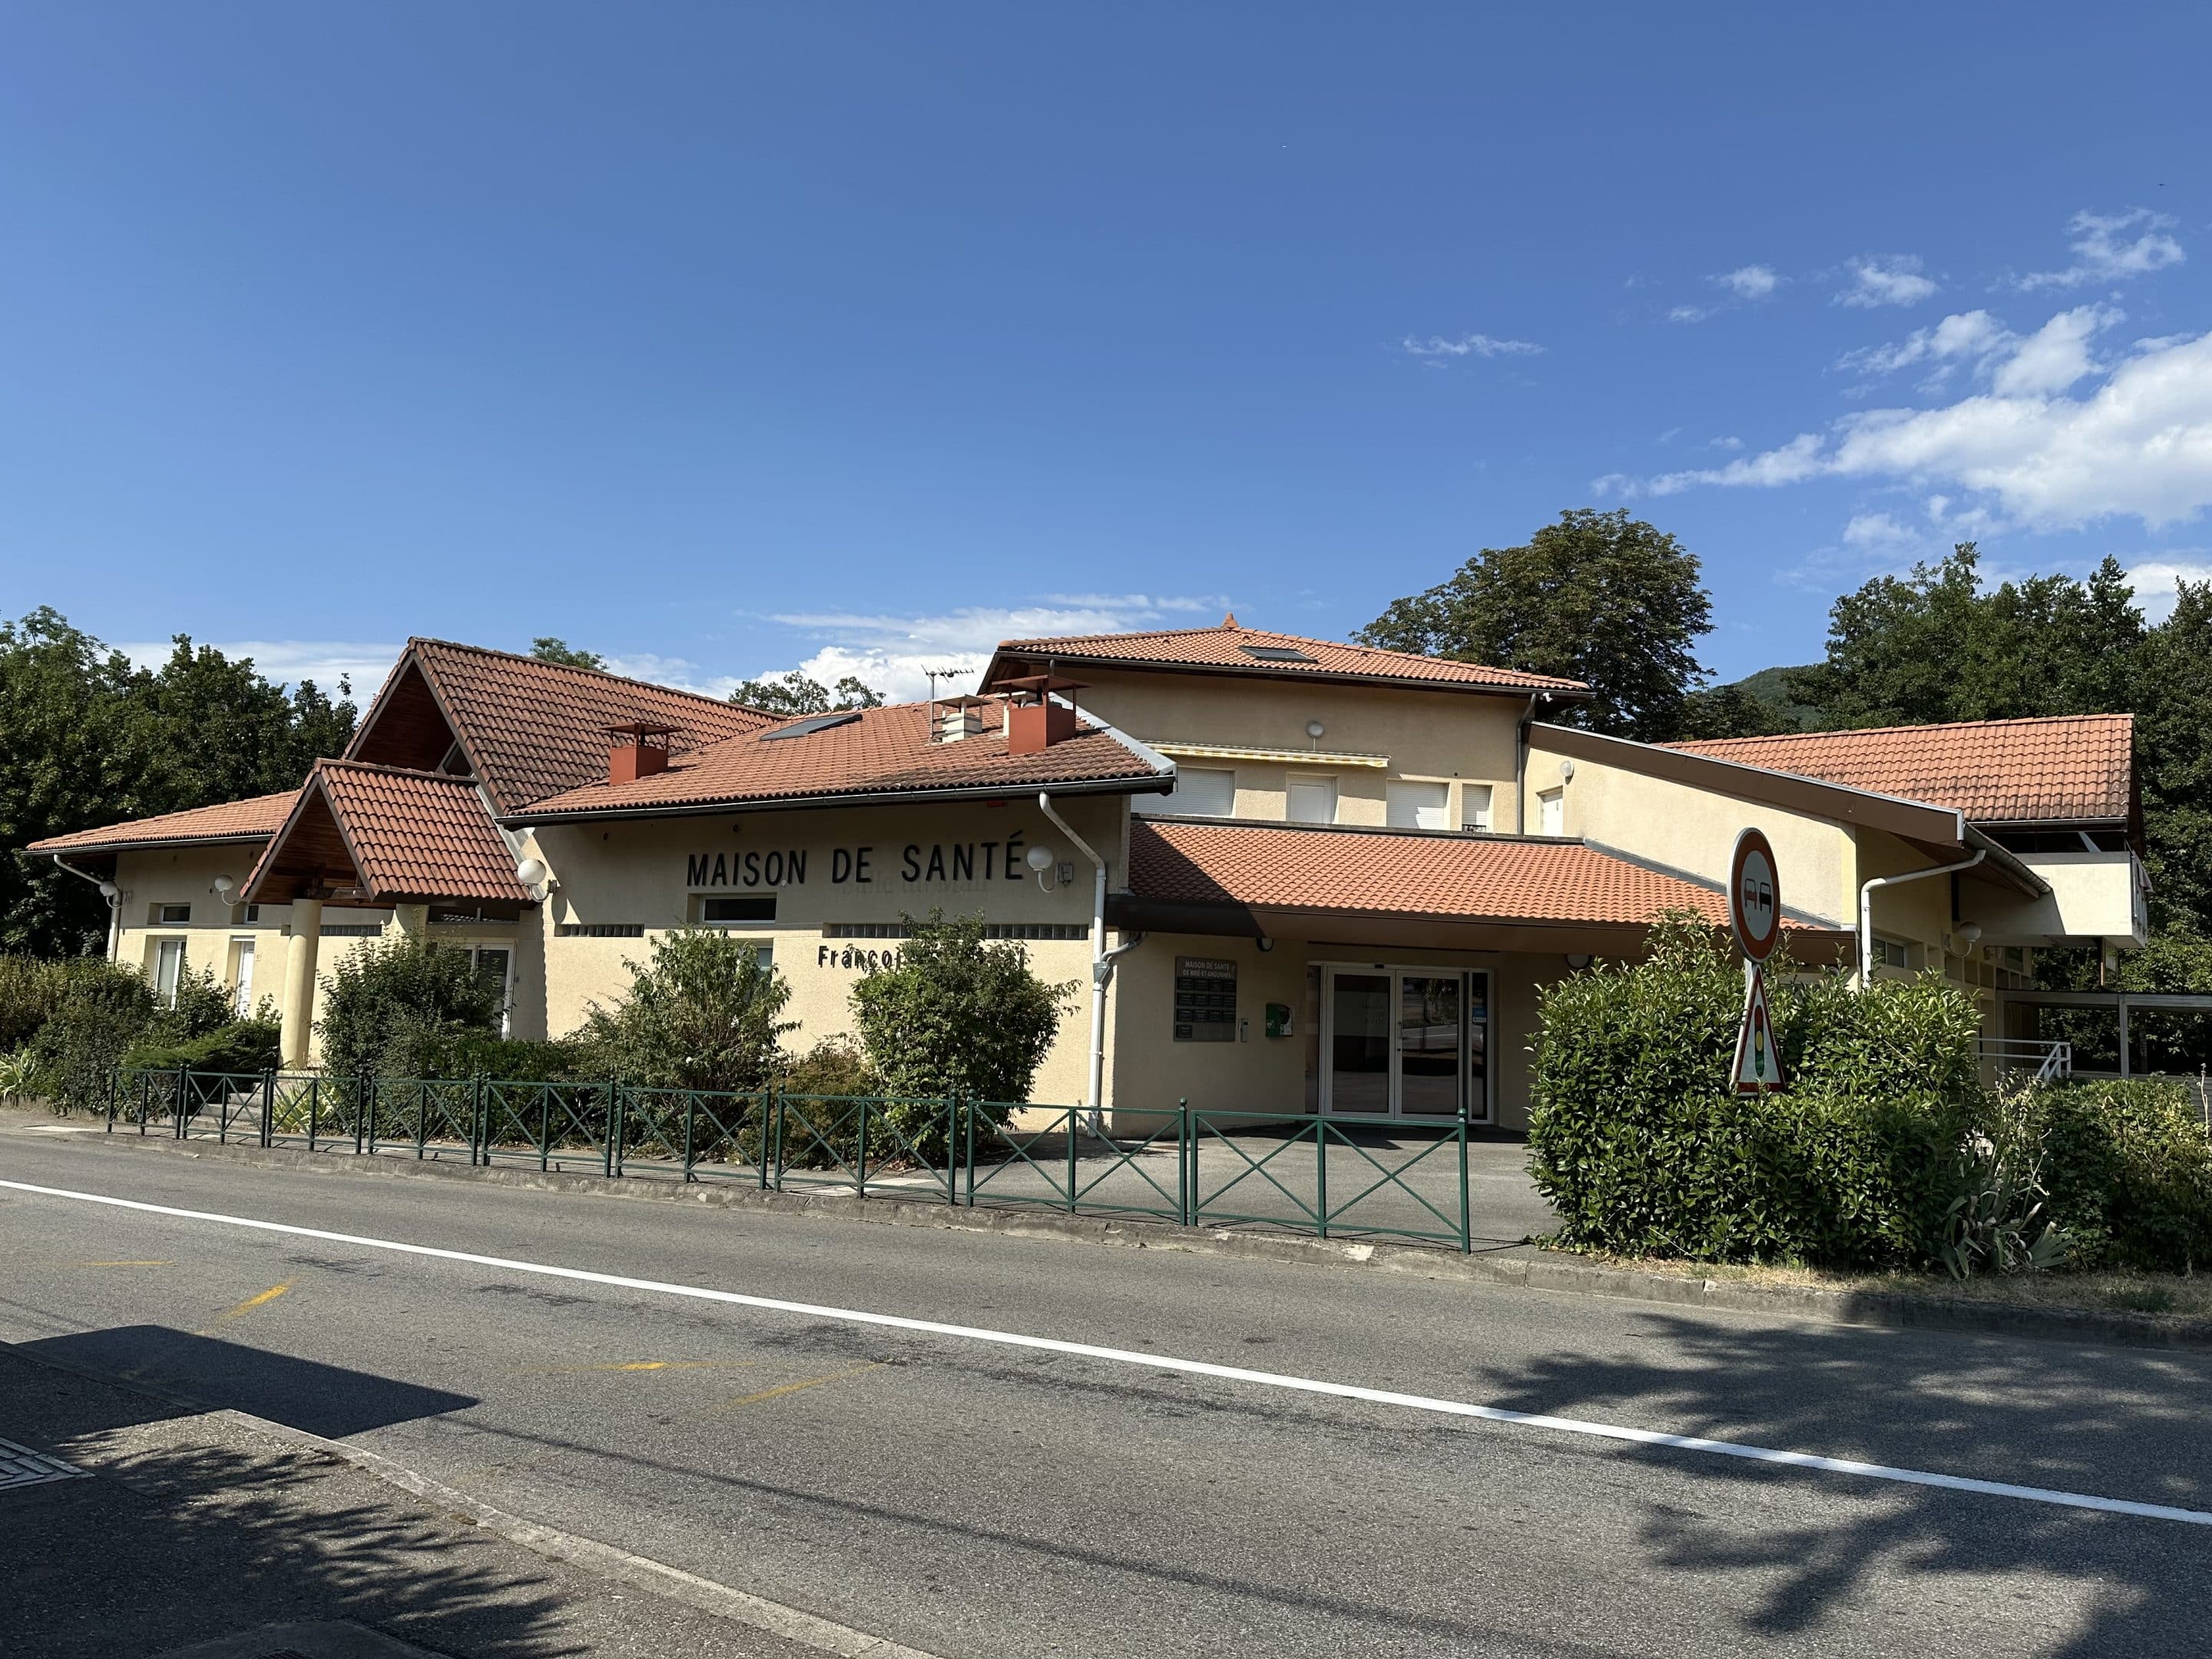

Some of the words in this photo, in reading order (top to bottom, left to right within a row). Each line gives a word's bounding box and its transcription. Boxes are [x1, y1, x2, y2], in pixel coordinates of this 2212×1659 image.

[687, 850, 806, 886] MAISON
[832, 847, 873, 884] DE
[901, 830, 1024, 882] SANTÉ
[1185, 961, 1205, 969] MAISON
